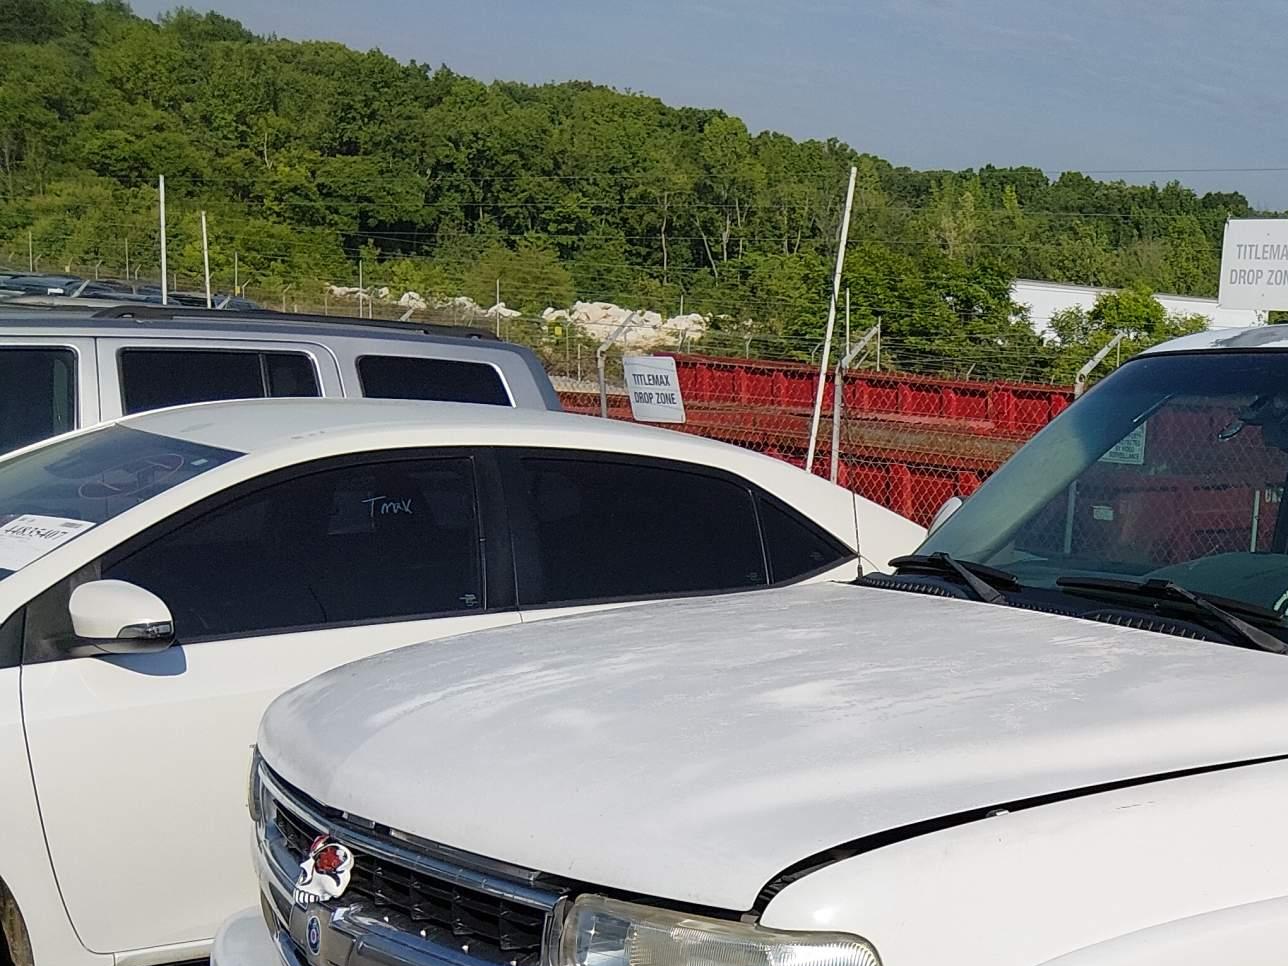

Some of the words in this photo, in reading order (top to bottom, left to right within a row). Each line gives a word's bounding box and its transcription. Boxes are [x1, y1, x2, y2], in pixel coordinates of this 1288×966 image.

[1230, 269, 1263, 285] DROP
[632, 374, 670, 386] TITLEMAX
[634, 392, 653, 404] DROP
[656, 393, 677, 404] ZONE
